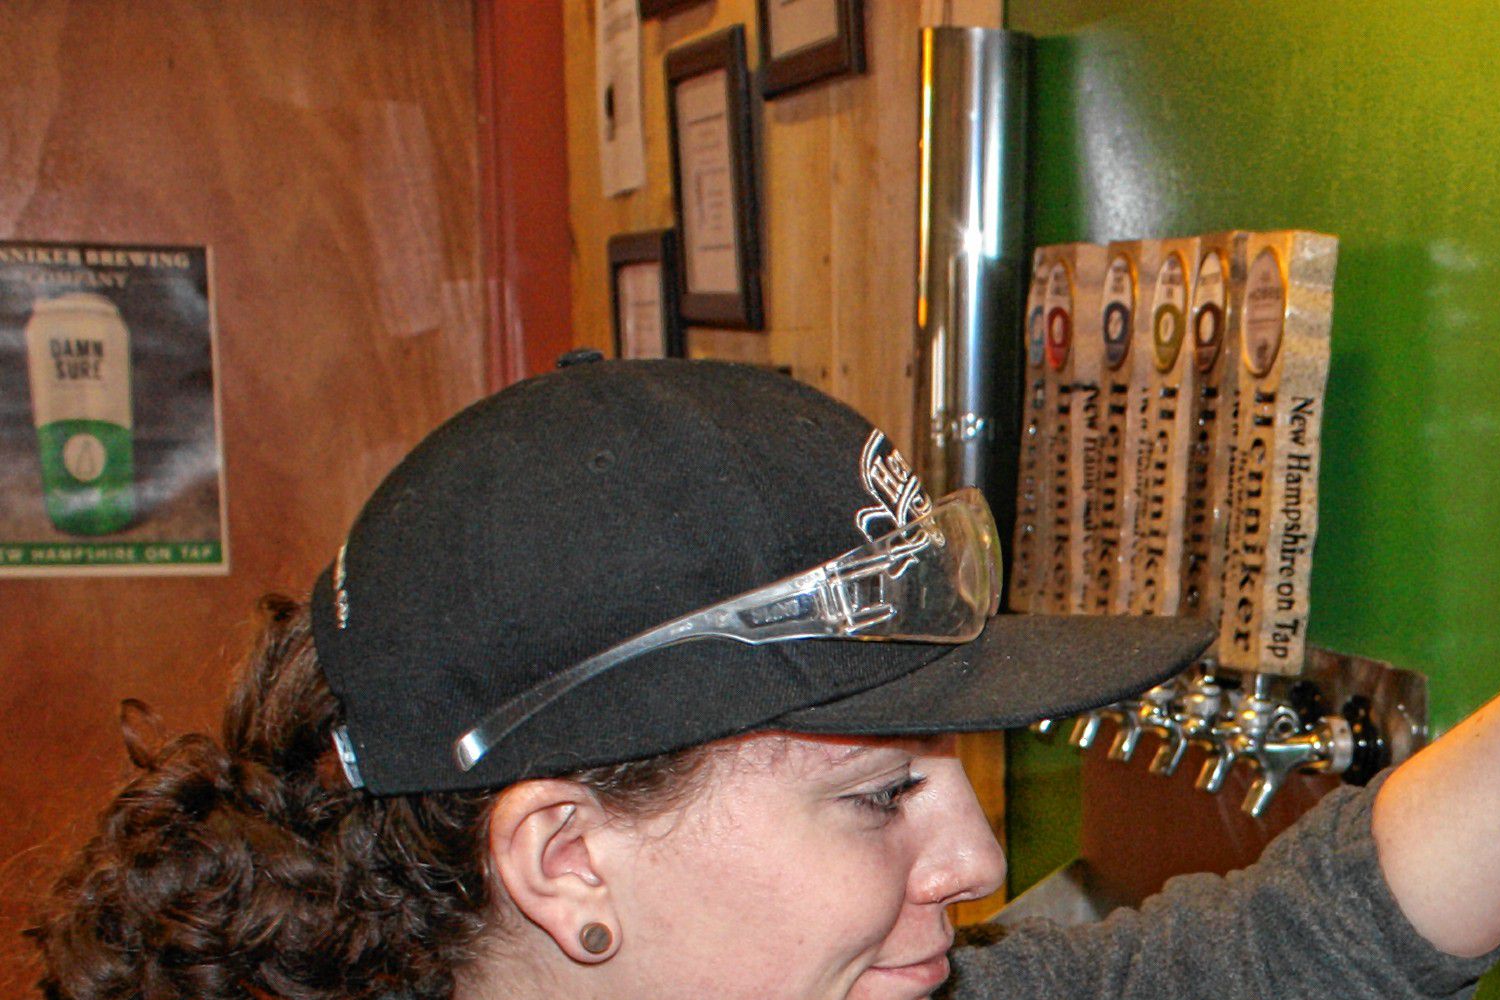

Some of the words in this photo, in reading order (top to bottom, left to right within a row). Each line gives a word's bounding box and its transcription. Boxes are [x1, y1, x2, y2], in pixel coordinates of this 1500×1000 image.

[84, 250, 191, 269] BREWING
[49, 339, 104, 358] DAMN
[1289, 396, 1315, 447] New
[1234, 390, 1276, 652] Henniker
[1280, 452, 1311, 577] Hampshire
[1276, 579, 1295, 613] on
[1266, 618, 1300, 660] Tap
